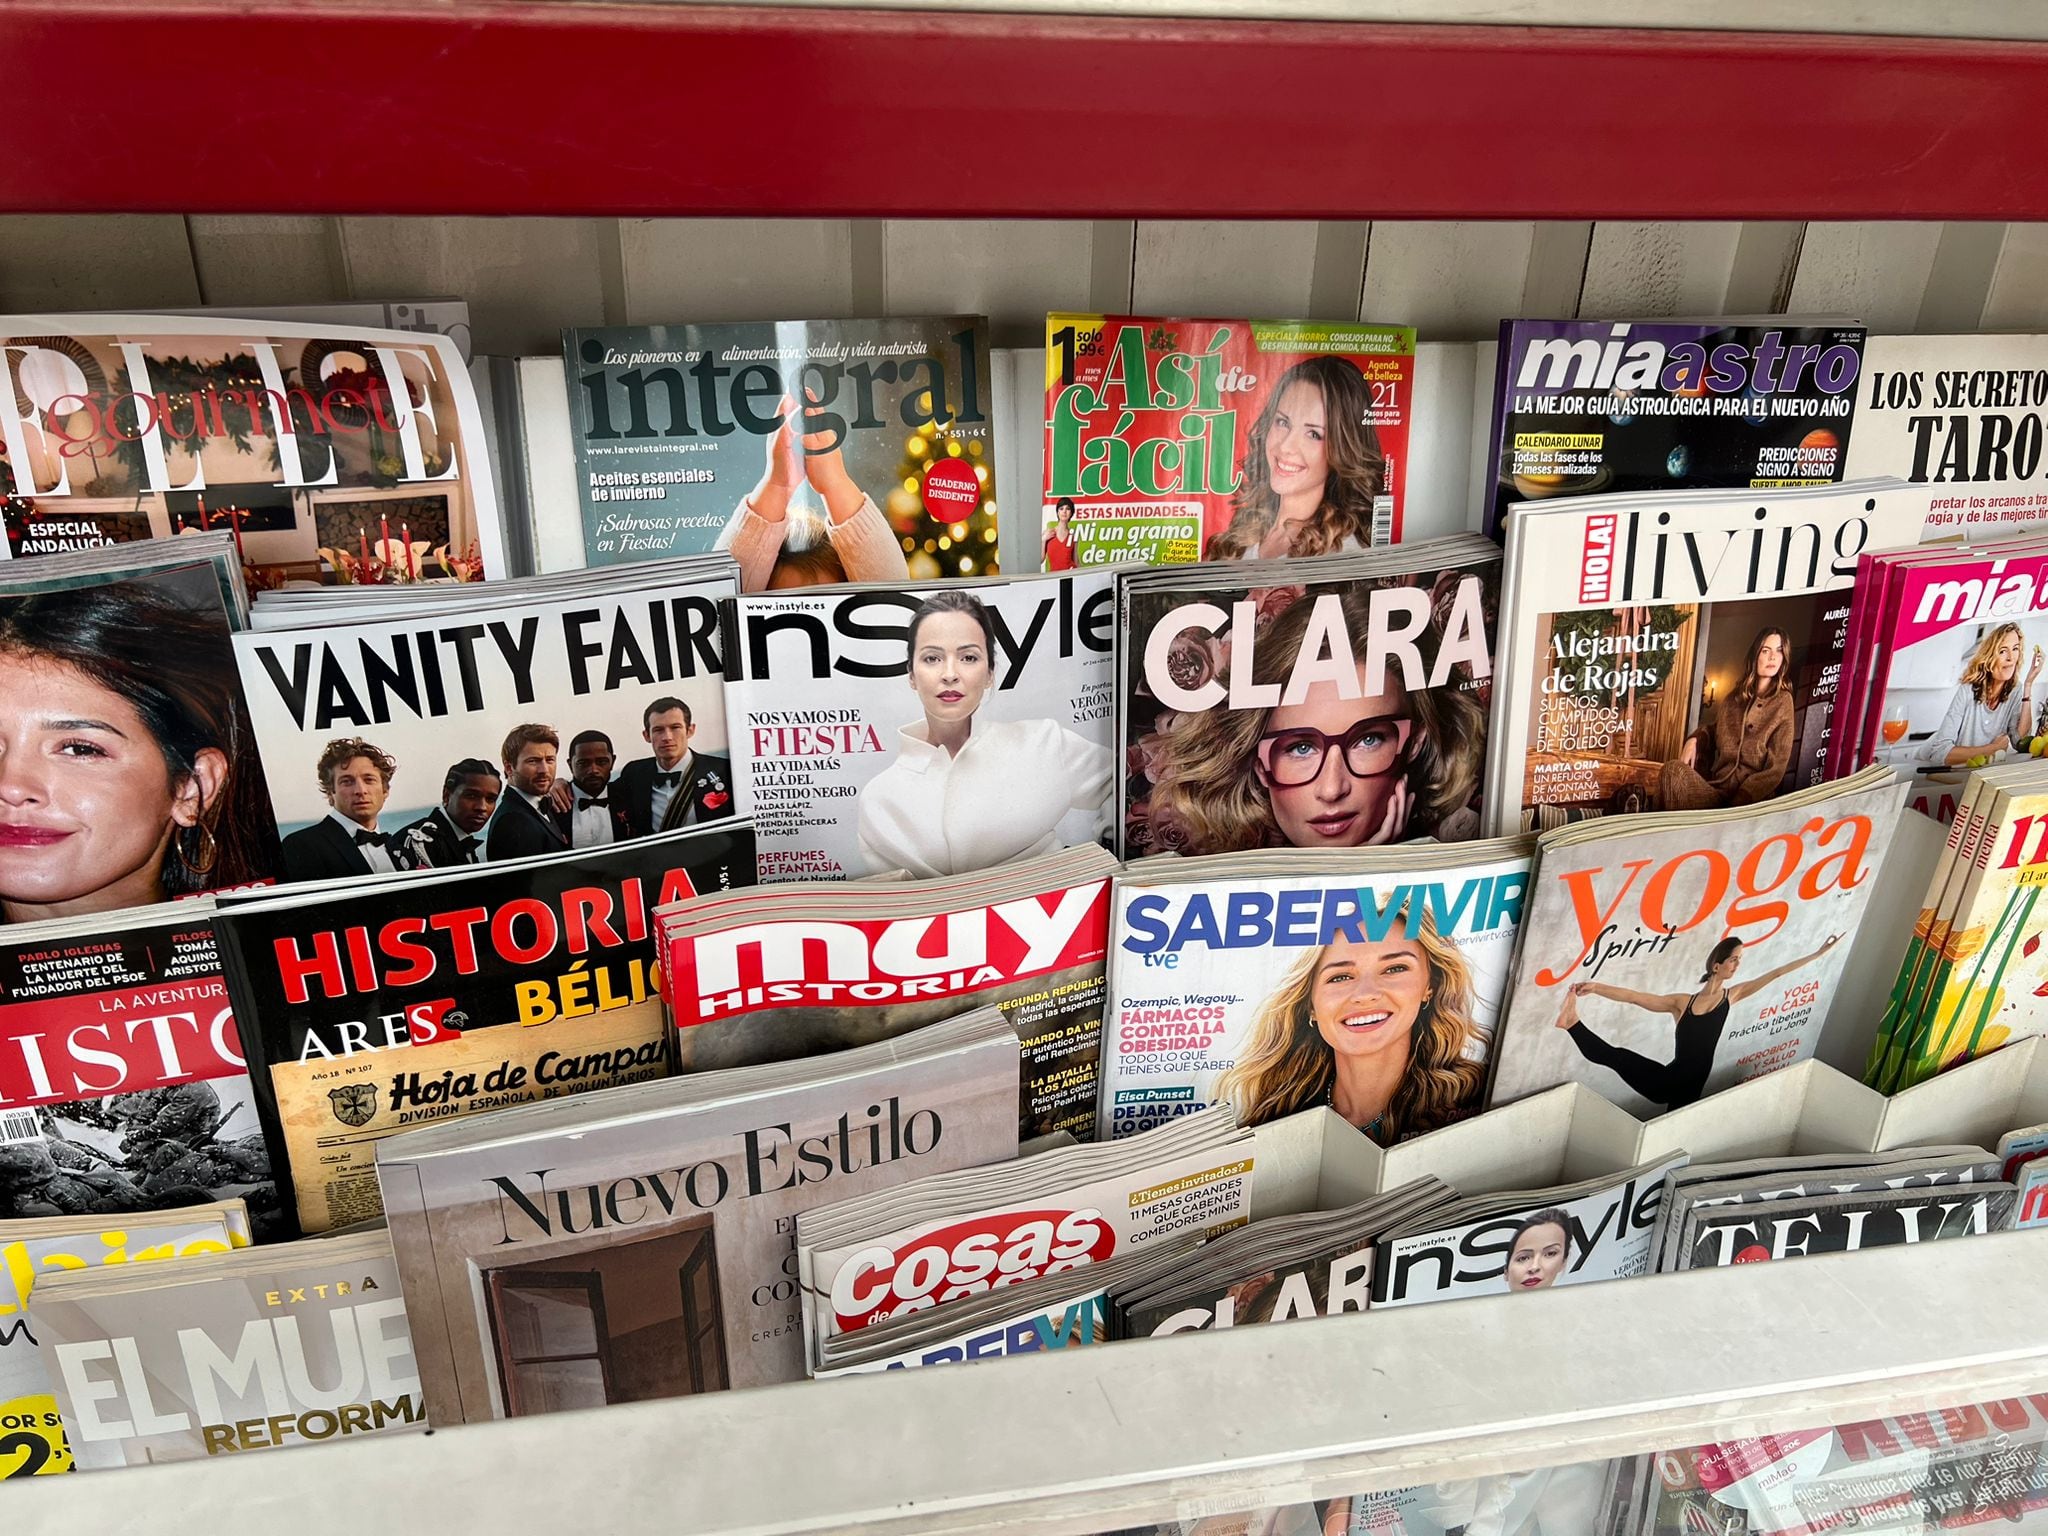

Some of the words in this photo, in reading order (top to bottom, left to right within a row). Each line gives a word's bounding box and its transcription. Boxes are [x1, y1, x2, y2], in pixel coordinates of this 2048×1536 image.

[1076, 328, 1103, 342] solo
[1094, 327, 1230, 411] Así
[1215, 366, 1256, 392] de
[1368, 361, 1398, 370] Agenda
[580, 328, 986, 456] integral
[1371, 382, 1398, 408] 21
[1870, 371, 1923, 409] LOS
[1384, 411, 1400, 419] para
[1514, 396, 1532, 414] LA
[1535, 396, 1584, 415] MEJOR
[1587, 394, 1619, 416] GUÍA
[1621, 394, 1711, 417] ASTROLÓGICA
[1714, 398, 1749, 416] PARA
[1752, 398, 1768, 417] EL
[1771, 399, 1818, 417] NUEVO
[1820, 396, 1850, 417] AÑO
[0, 345, 458, 498] ELLE
[47, 377, 405, 458] gourmet
[587, 442, 718, 456] www.larevistaintegral.net
[1046, 384, 1244, 498] fácil
[1517, 436, 1570, 448] CALENDARIO
[1572, 435, 1601, 448] LUNAR
[1908, 413, 2048, 483] TARO
[1758, 448, 1837, 462] PREDICCIONES
[590, 471, 639, 487] Aceites
[641, 468, 715, 484] esenciales
[928, 476, 977, 491] CUADERNO
[591, 488, 608, 502] de
[610, 485, 666, 501] invierno
[928, 489, 975, 503] DISIDENTE
[1969, 496, 1985, 508] los
[1988, 496, 2026, 508] arcanos
[2028, 497, 2033, 505] a
[1076, 508, 1112, 519] ESTAS
[1116, 506, 1197, 518] NAVIDADES...
[28, 521, 101, 537] ESPECIAL
[597, 513, 672, 537] ¡Sabrosas
[675, 512, 725, 529] recetas
[1067, 523, 1097, 547] ¡Ni
[1100, 527, 1123, 541] un
[1127, 524, 1193, 545] gramo
[21, 534, 115, 555] ANDALUCÍA
[597, 538, 616, 552] en
[618, 533, 675, 554] Fiestas!
[1082, 543, 1105, 563] de
[1110, 542, 1158, 561] más!
[1616, 498, 1876, 602] living
[1580, 515, 1617, 602] ¡HOLA!
[747, 602, 826, 613] www.instyle.es
[1144, 576, 1492, 713] CLARA
[1544, 625, 1680, 663] Alejandra
[254, 616, 538, 732] VANITY
[562, 595, 724, 696] FAIR
[1540, 669, 1576, 694] de
[1584, 665, 1657, 698] Rojas
[1539, 694, 1599, 713] SUEÑOS
[748, 712, 780, 726] NOS
[781, 710, 839, 725] VAMOS
[839, 709, 861, 723] DE
[1539, 707, 1619, 725] CUMPLIDOS
[751, 724, 886, 757] FIESTA
[1537, 740, 1555, 753] DE
[1557, 734, 1610, 750] TOLEDO
[751, 761, 775, 773] HAY
[776, 760, 811, 773] VIDA
[812, 757, 841, 771] MÁS
[1534, 762, 1572, 773] MARTA
[1574, 760, 1600, 771] ORIA
[752, 773, 786, 787] ALLÁ
[787, 773, 814, 786] DEL
[753, 787, 811, 801] VESTIDO
[812, 785, 857, 798] NEGRO
[1947, 803, 1971, 850] menta
[1961, 813, 1985, 861] menta
[758, 850, 825, 863] PERFUMES
[1975, 823, 2000, 871] menta
[759, 863, 775, 875] DE
[777, 858, 842, 874] FANTASÍA
[1534, 814, 1873, 988] yoga
[273, 868, 699, 1004] HISTORIA
[694, 879, 1108, 998] muy
[18, 950, 61, 963] PABLO
[64, 942, 121, 956] IGLESIAS
[1142, 951, 1179, 970] tve
[1582, 922, 1678, 980] Spirit
[22, 955, 103, 974] CENTENARIO
[108, 953, 124, 962] DE
[26, 974, 46, 985] LA
[47, 966, 100, 982] MUERTE
[103, 962, 127, 974] DEL
[12, 980, 83, 998] FUNDADOR
[86, 976, 111, 987] DEL
[113, 972, 147, 985] PSOE
[698, 966, 1004, 1018] HISTORIA
[1783, 980, 1820, 1000] YOGA
[1121, 994, 1182, 1010] Ozempic,
[1184, 993, 1244, 1009] Wegovy...
[1120, 1005, 1225, 1025] FÁRMACOS
[1728, 1020, 1770, 1041] Práctica
[1768, 1006, 1812, 1029] tibetana
[298, 1004, 438, 1066] ARES
[1119, 1023, 1200, 1040] CONTRA
[1200, 1020, 1225, 1035] LA
[1119, 1035, 1212, 1054] OBESIDAD
[1735, 1038, 1801, 1067] MICROBIOTA
[312, 1073, 327, 1081] Año
[330, 1070, 339, 1078] 18
[358, 1065, 372, 1073] 107
[1118, 1063, 1161, 1076] TIENES
[1163, 1061, 1192, 1073] QUE
[1194, 1059, 1235, 1071] SABER
[390, 1070, 479, 1111] Hoja
[484, 1060, 526, 1092] de
[399, 1103, 459, 1124] DIVISION
[469, 1090, 534, 1111] ESPAÑOLA
[542, 1086, 560, 1098] DE
[567, 1068, 656, 1096] VOLUNTARIOS
[1117, 1090, 1145, 1103] Elsa
[1146, 1087, 1192, 1101] Punset
[482, 1160, 729, 1246] Nuevo
[733, 1096, 943, 1200] Estilo
[1130, 1180, 1181, 1206] ¿Tienes
[1180, 1161, 1246, 1193] invitados?
[1129, 1210, 1141, 1220] 11
[1141, 1196, 1182, 1218] MESAS
[1184, 1178, 1243, 1207] GRANDES
[1153, 1211, 1180, 1225] QUE
[1182, 1197, 1223, 1220] CABEN
[1225, 1190, 1241, 1204] EN
[1130, 1214, 1206, 1245] COMEDORES
[1209, 1200, 1240, 1219] MINIS
[1398, 1235, 1456, 1251] www.instyle.es
[831, 1207, 1103, 1318] Cosas
[265, 1276, 380, 1307] EXTRA
[55, 1337, 191, 1442] EL
